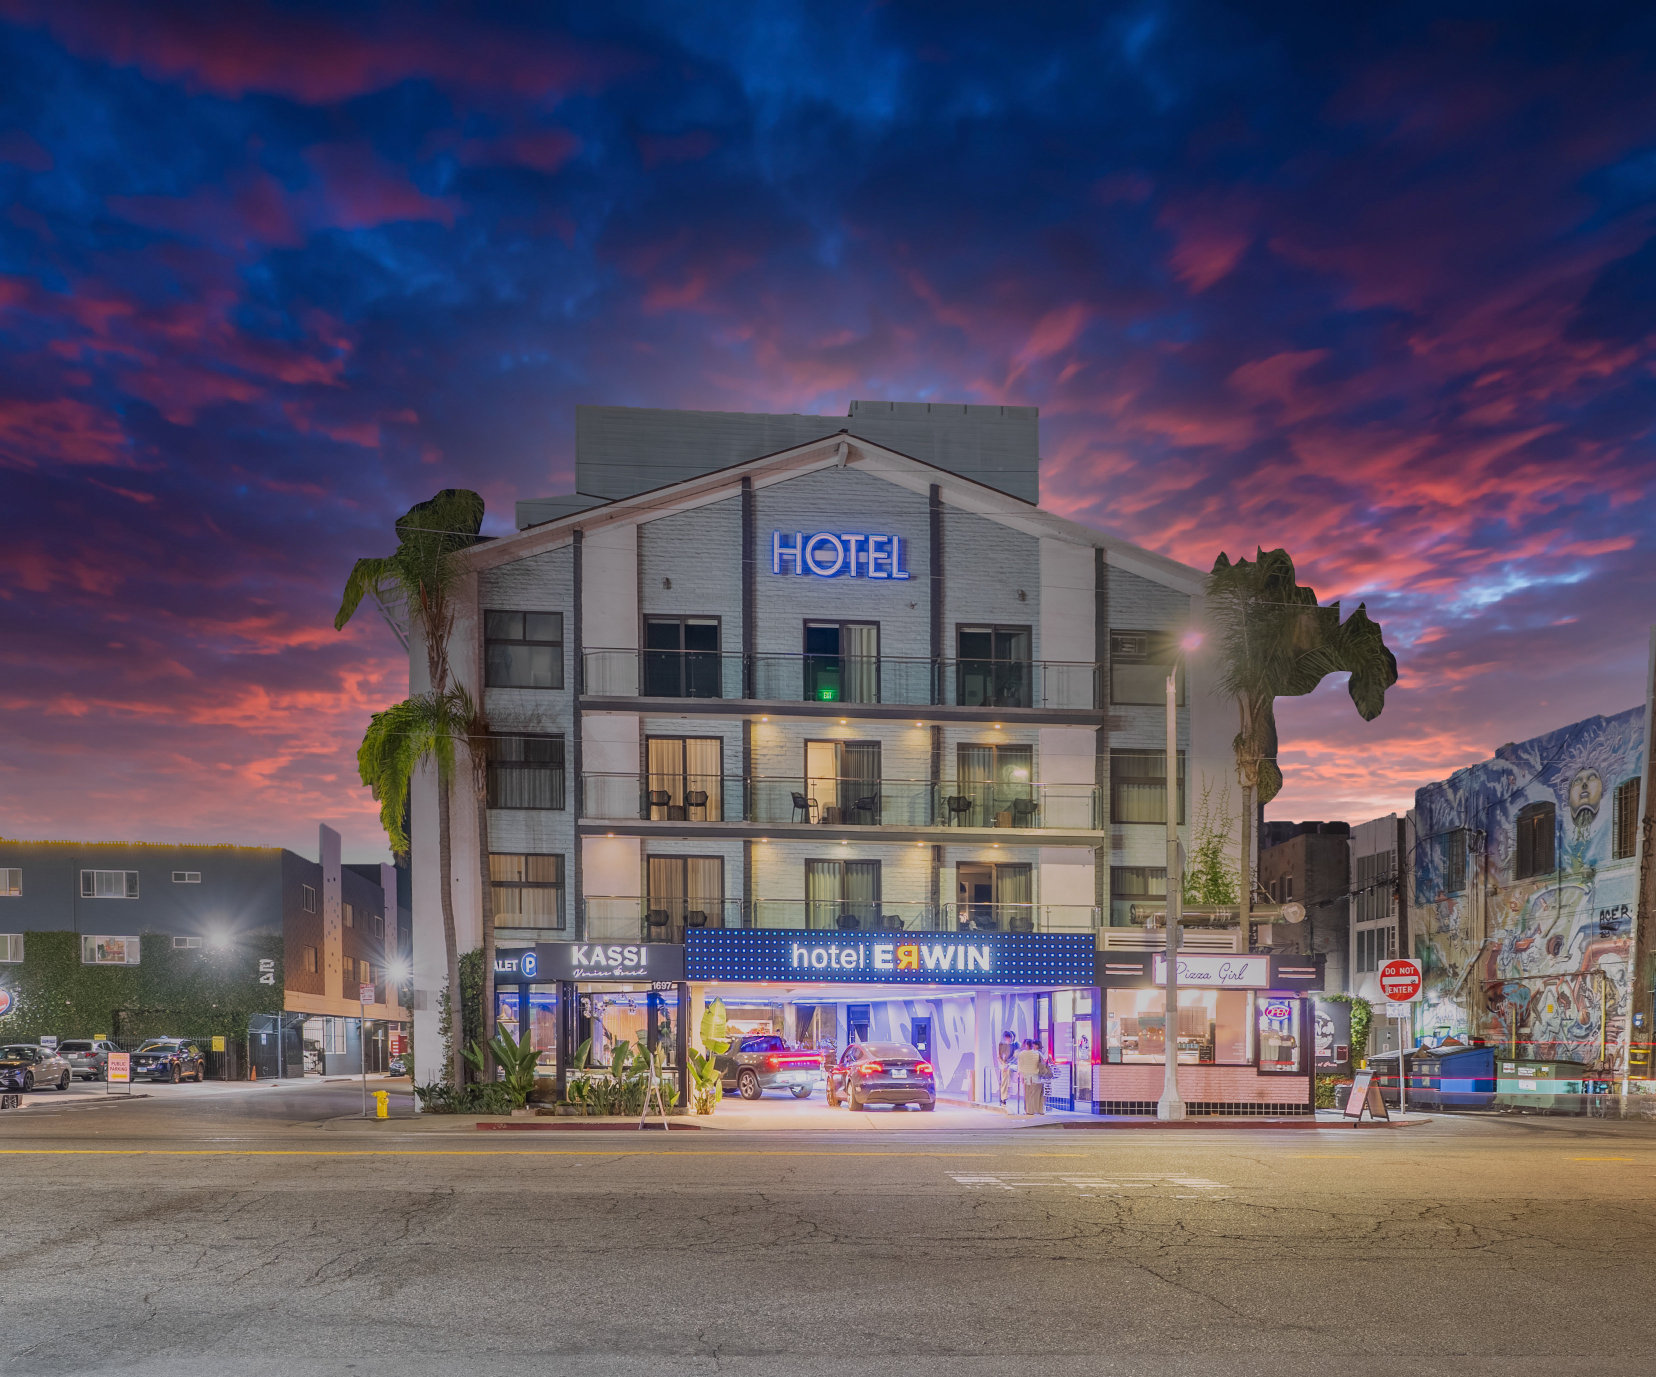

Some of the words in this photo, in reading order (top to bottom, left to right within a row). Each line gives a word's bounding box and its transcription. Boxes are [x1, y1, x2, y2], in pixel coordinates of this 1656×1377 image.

[773, 531, 909, 579] HOTEL
[572, 945, 647, 966] KASSI
[793, 943, 864, 969] hotel
[494, 959, 519, 972] ALET
[1385, 967, 1396, 975] DO
[1399, 966, 1415, 975] NOT
[1219, 962, 1248, 984] Girl
[651, 981, 672, 990] 1697
[1388, 986, 1413, 994] ENTER
[1265, 1007, 1290, 1018] OPEN
